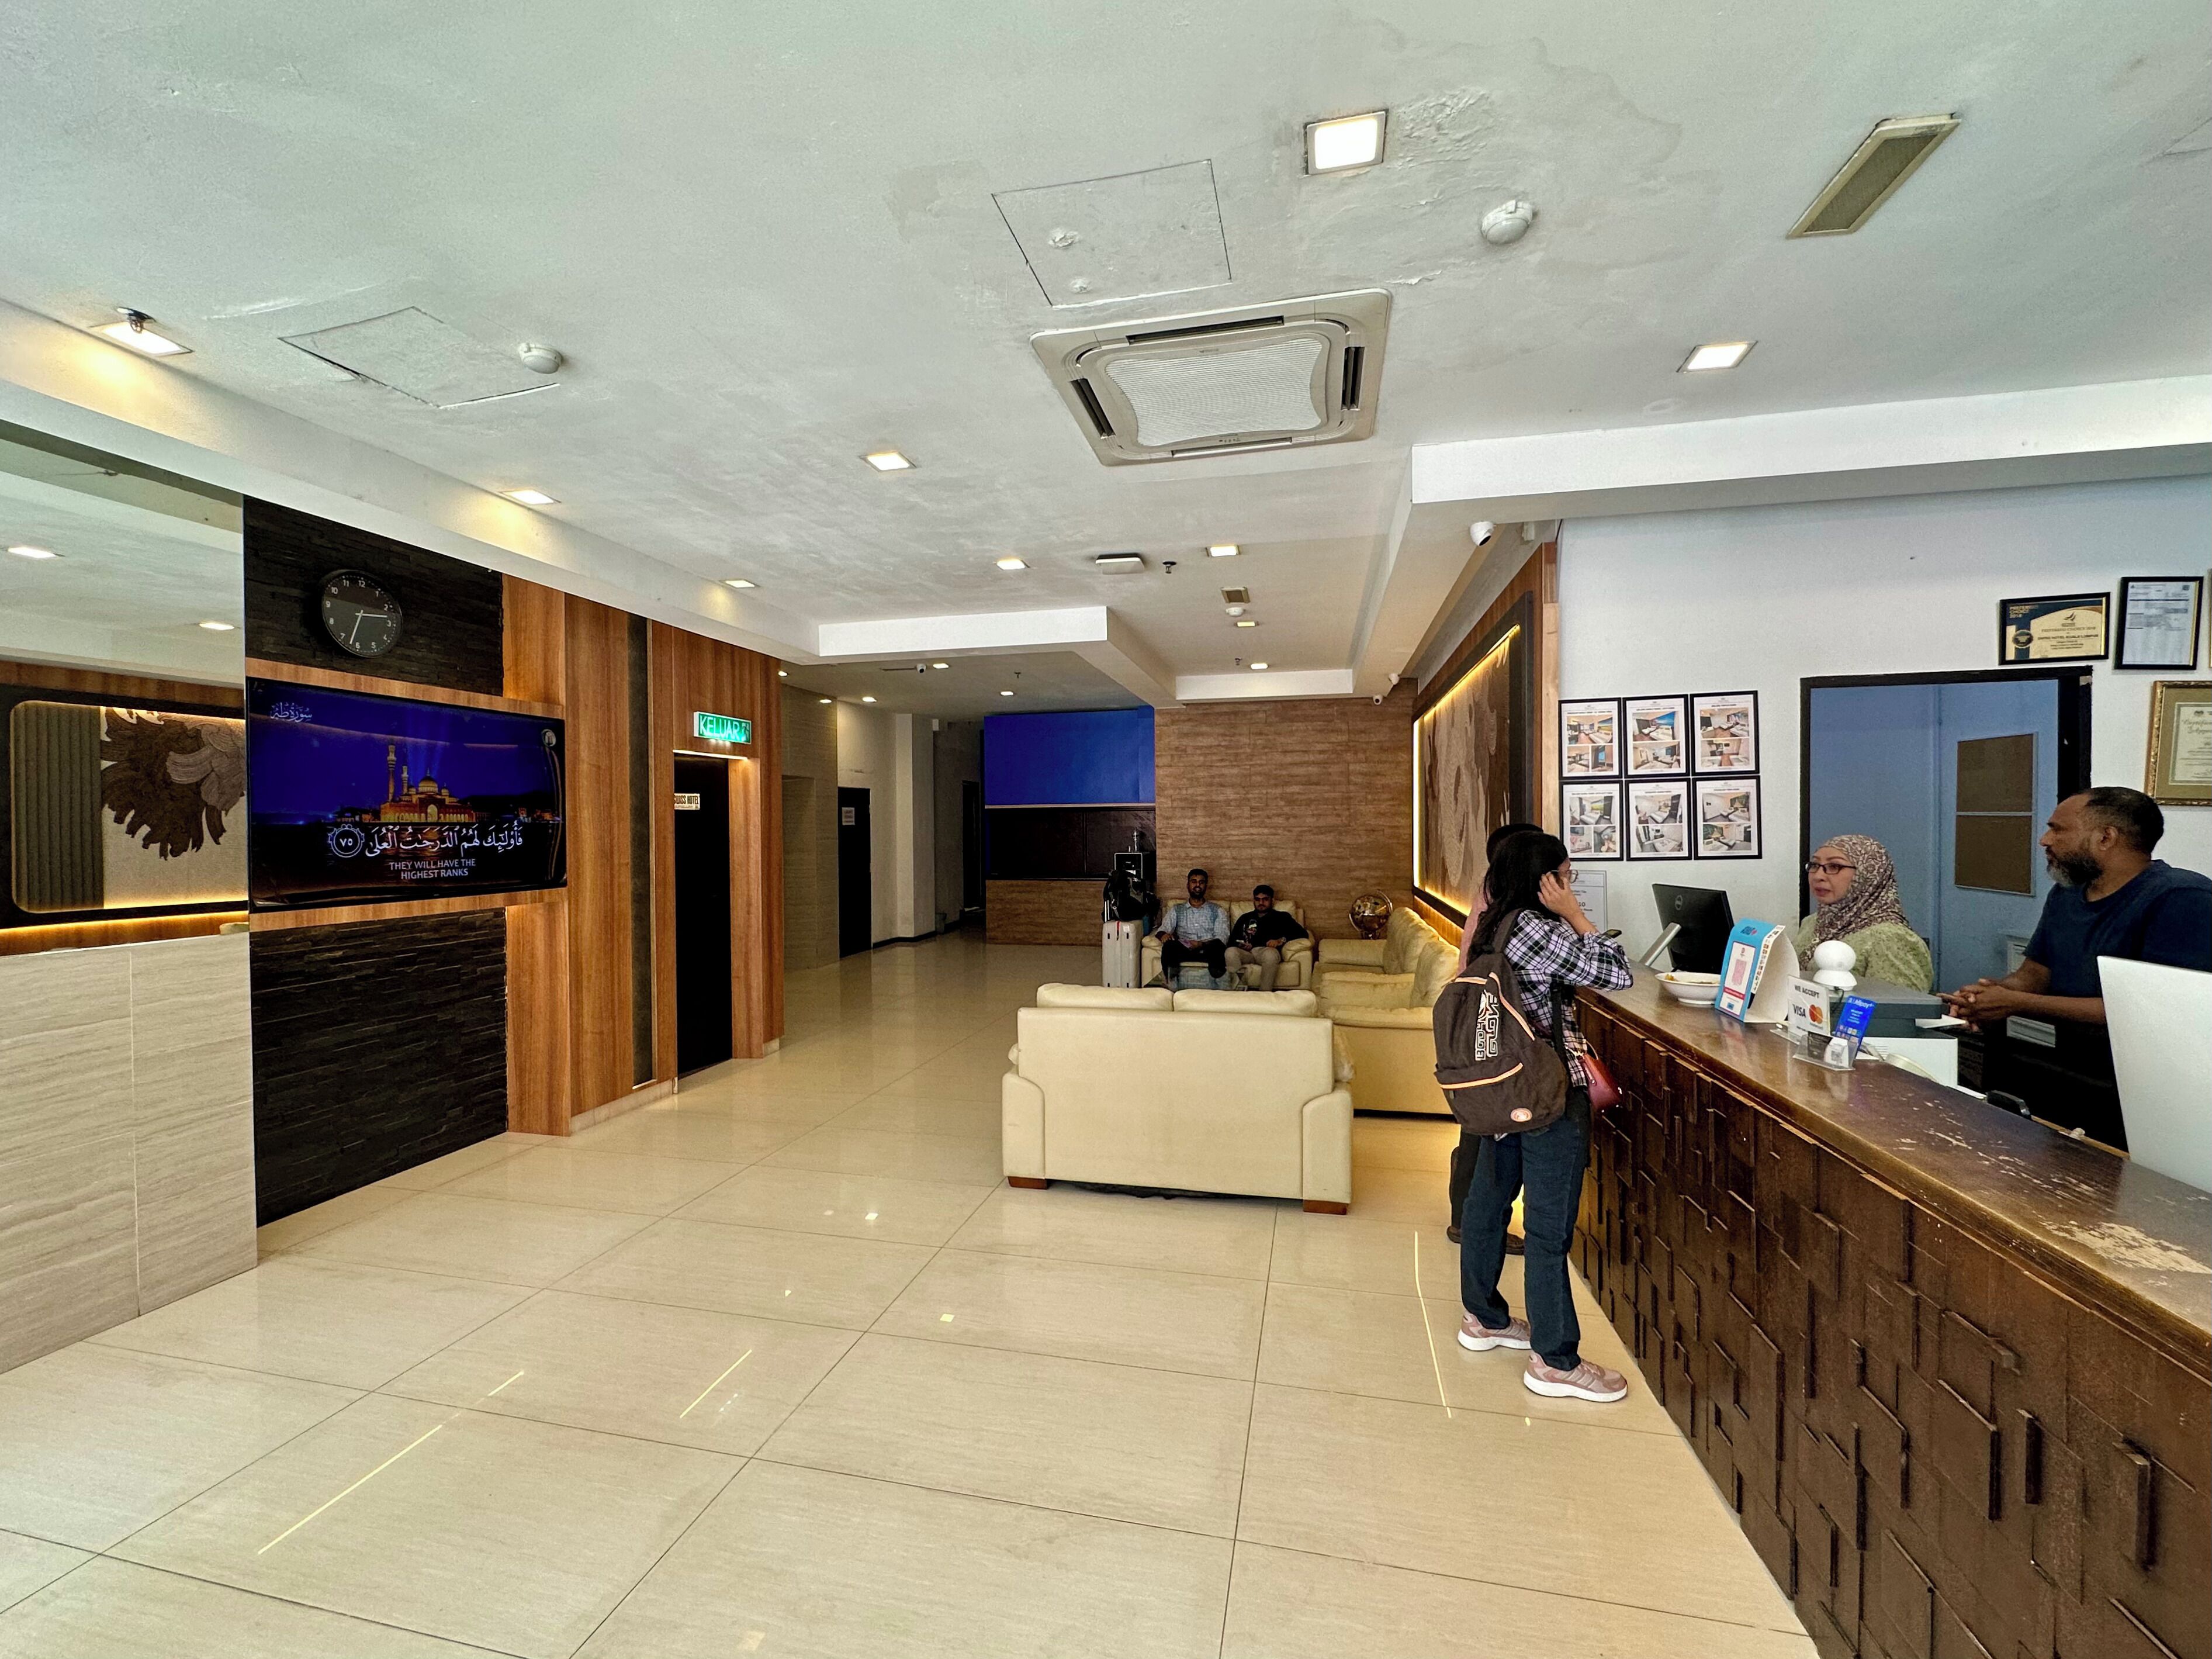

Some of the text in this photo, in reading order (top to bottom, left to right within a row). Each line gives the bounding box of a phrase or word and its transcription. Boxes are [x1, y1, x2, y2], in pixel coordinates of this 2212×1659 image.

[700, 715, 740, 741] KELUAR
[687, 795, 699, 804] HOTEL
[389, 858, 476, 870] THEY WILL HAVE THE
[401, 868, 469, 880] HIGHEST RANKS
[1802, 987, 1819, 998] ACCEPT
[1792, 1003, 1806, 1018] VISA
